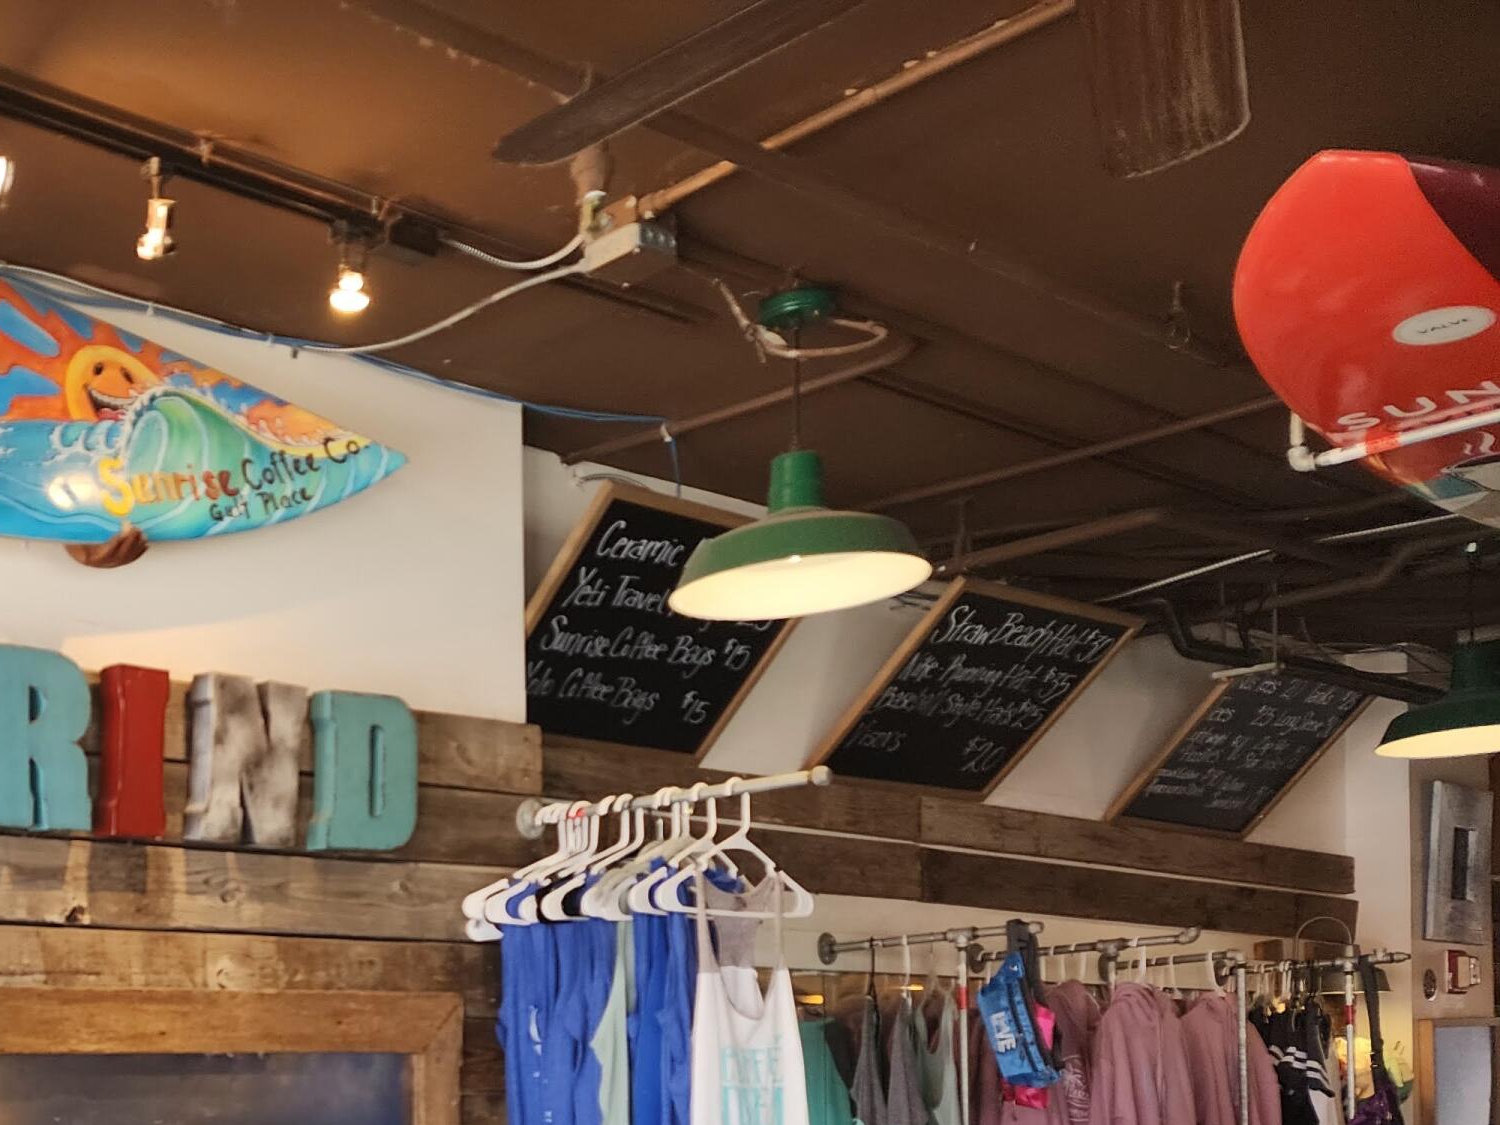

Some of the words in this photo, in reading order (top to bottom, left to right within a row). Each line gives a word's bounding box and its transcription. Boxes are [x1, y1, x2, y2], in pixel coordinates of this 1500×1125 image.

[100, 457, 238, 516] Sunrise
[241, 449, 319, 492] Coffee
[322, 437, 372, 464] Co.
[596, 520, 685, 567] Ceramic
[562, 566, 612, 608] Yeti
[540, 615, 611, 658] Sunrise
[609, 626, 669, 660] Coffee
[666, 635, 717, 679] Bags
[932, 604, 993, 645] Straw
[558, 667, 614, 702] Coffee
[610, 676, 661, 725] Bags
